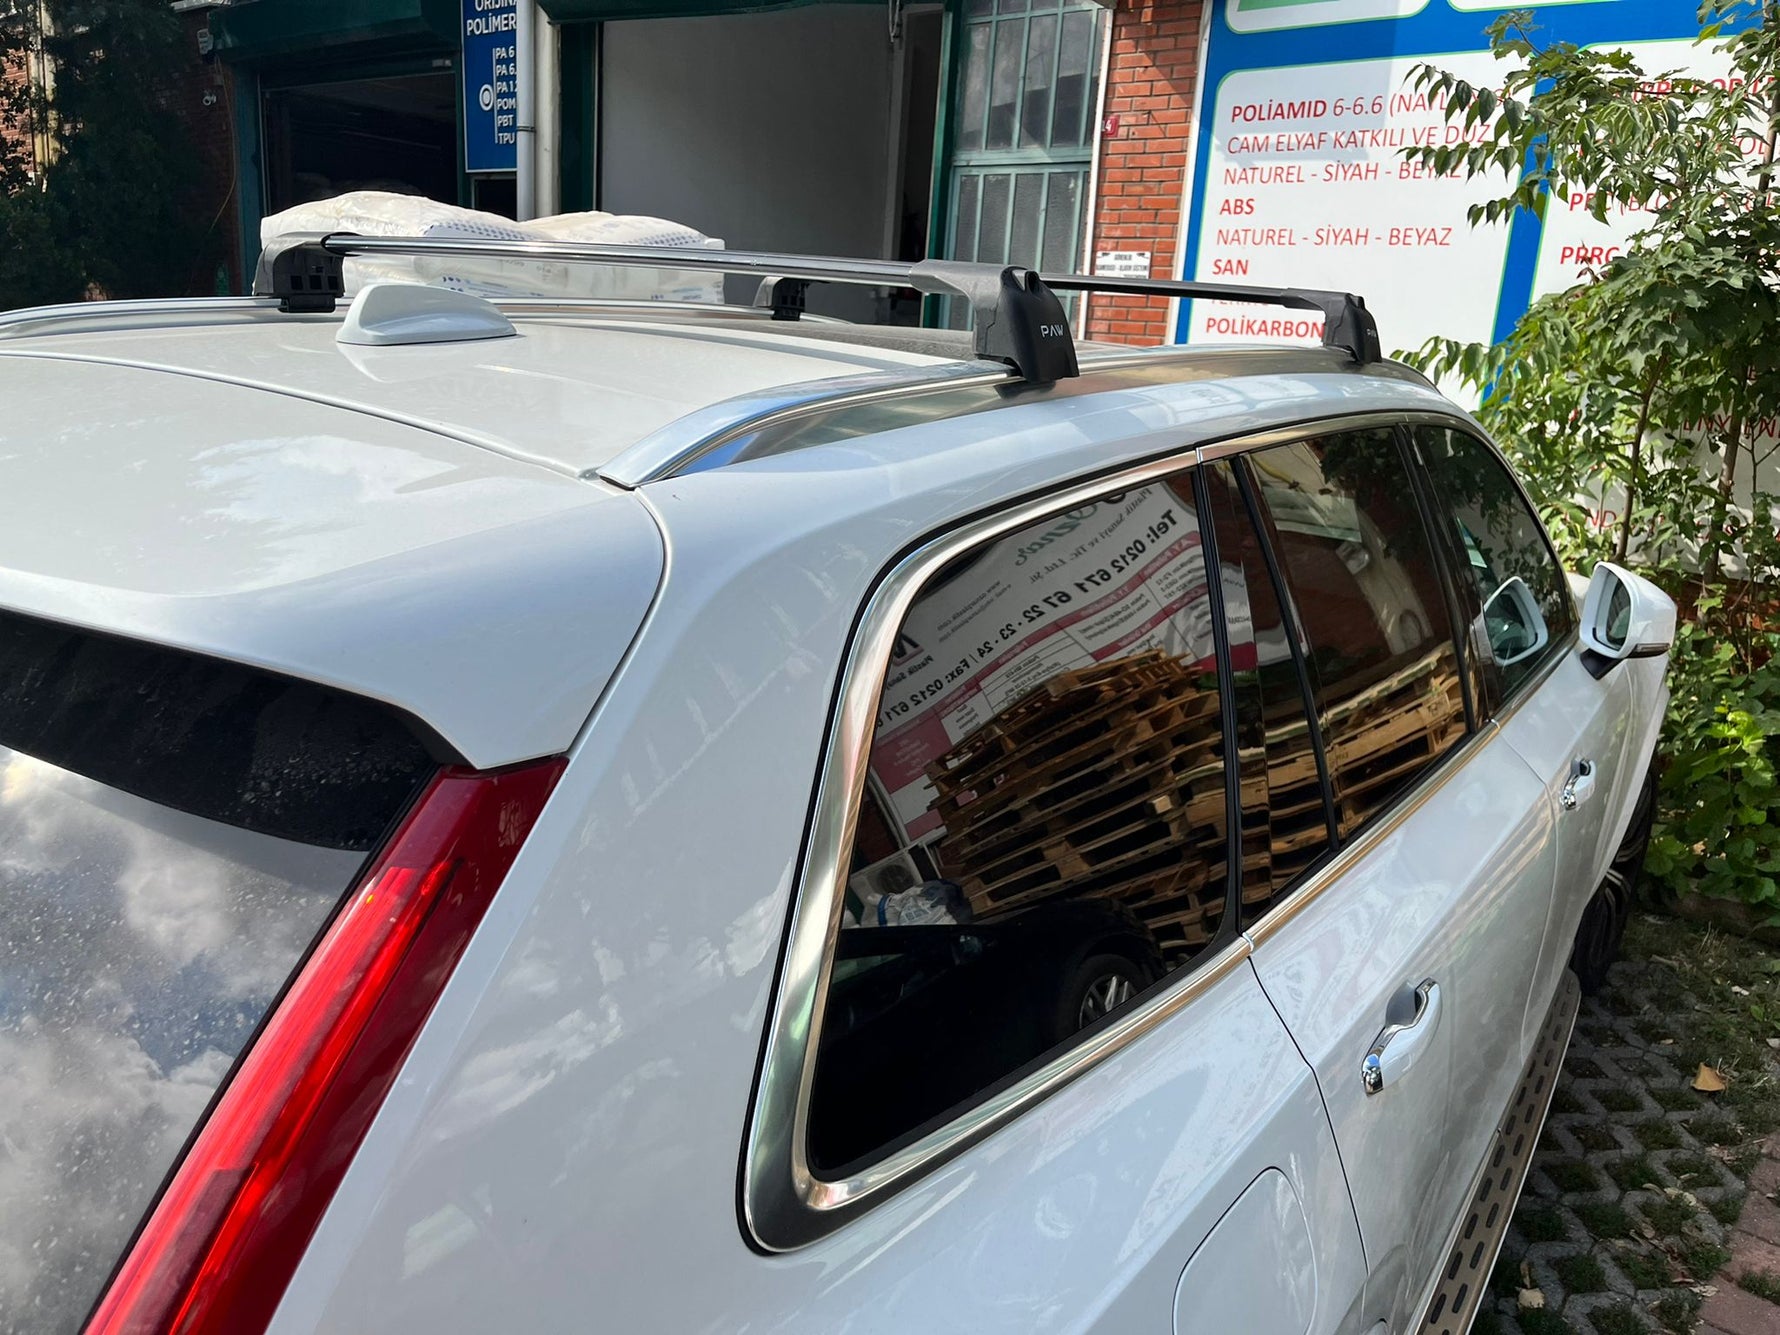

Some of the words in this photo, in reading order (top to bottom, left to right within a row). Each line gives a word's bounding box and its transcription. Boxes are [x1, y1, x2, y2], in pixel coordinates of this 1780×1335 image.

[467, 13, 517, 36] POLİMER
[496, 47, 507, 59] PA
[508, 46, 515, 57] 6
[496, 64, 508, 76] PA
[496, 81, 508, 93] PA
[497, 98, 516, 110] POM
[1231, 99, 1327, 123] POLİAMID
[1333, 96, 1383, 116] 6-6.6
[497, 115, 514, 127] PBT
[498, 133, 515, 144] TPU
[1227, 135, 1269, 154] CAM
[1276, 132, 1327, 152] ELYAF
[1333, 127, 1405, 149] KATKILI
[1412, 126, 1439, 145] VE
[1224, 165, 1305, 185] NATUREL
[1323, 159, 1378, 182] SİYAH
[1399, 162, 1462, 179] BEYZ
[1219, 198, 1255, 215] ABS
[1216, 228, 1296, 246] NATUREL
[1314, 223, 1369, 246] SİYAH
[1388, 227, 1452, 246] BEYAZ
[1212, 259, 1249, 276] SAN
